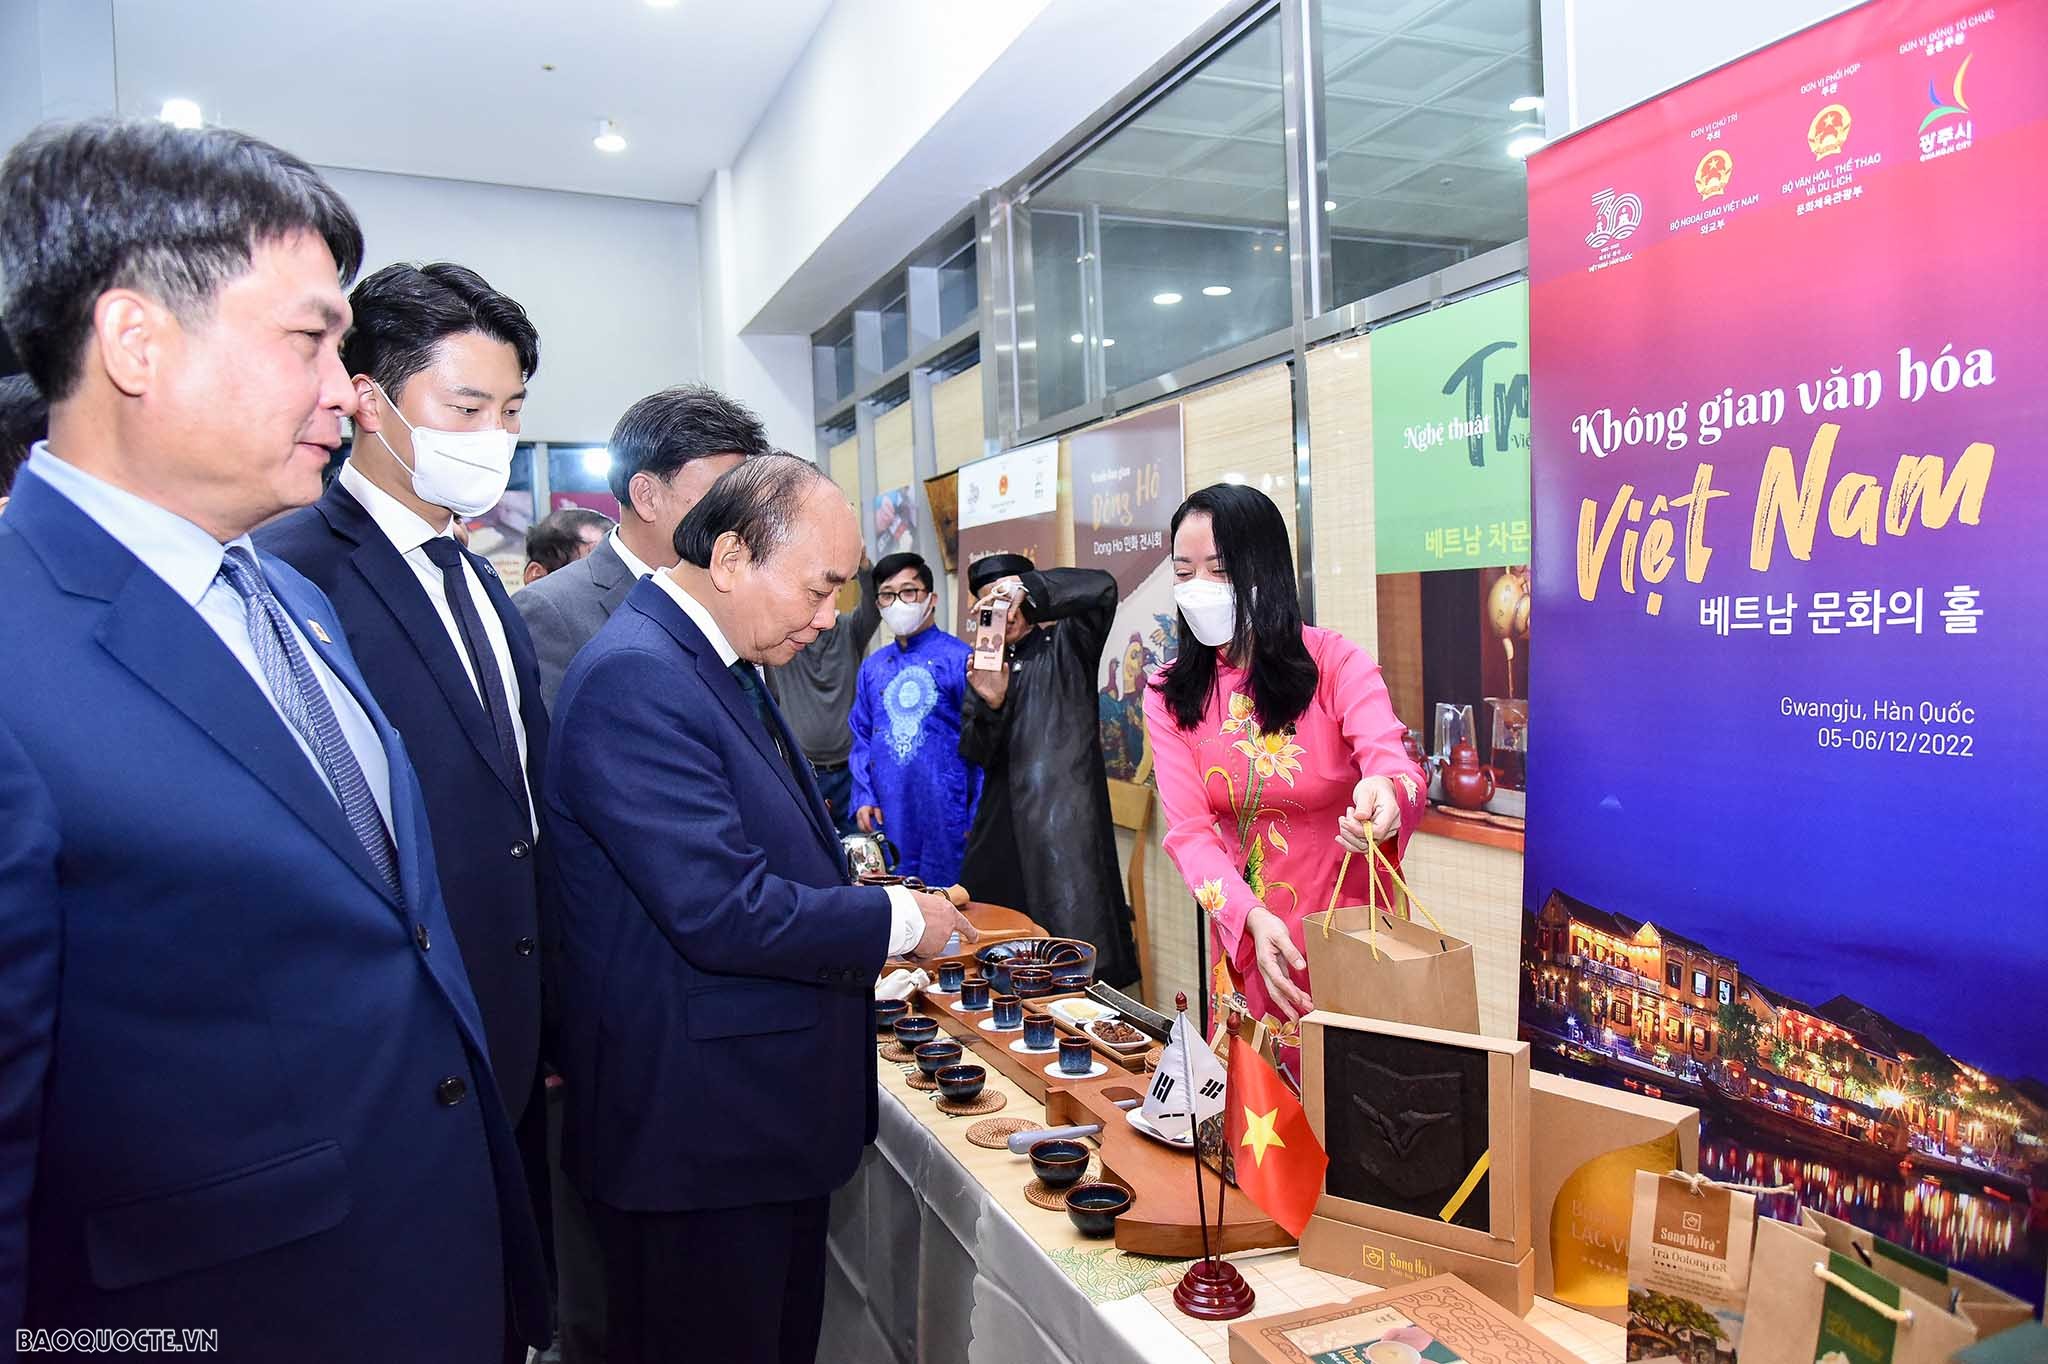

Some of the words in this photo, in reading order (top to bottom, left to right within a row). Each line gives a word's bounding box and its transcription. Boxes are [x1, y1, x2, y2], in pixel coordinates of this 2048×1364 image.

[1919, 119, 1972, 154] 광주시
[1782, 180, 1794, 195] BỘ
[1794, 174, 1811, 189] VĂN
[1834, 156, 1854, 174] THỂ
[1854, 153, 1881, 169] THAO
[1806, 183, 1817, 196] VÀ
[1818, 179, 1830, 192] DU
[1831, 171, 1853, 189] LỊCH
[1669, 219, 1680, 232] BỘ
[1680, 212, 1703, 227] NGOẠI
[1703, 206, 1722, 220] GIAO
[1723, 198, 1740, 213] VIỆT
[1741, 193, 1760, 207] NAM
[1571, 400, 1688, 458] Không
[1698, 387, 1785, 445] gian
[1796, 364, 1883, 416] văn
[1897, 343, 1996, 402] hóa
[1403, 422, 1445, 452] Nghệ
[1448, 414, 1491, 441] thuật
[1576, 462, 1730, 616] Việt
[1750, 422, 1996, 572] Nam
[1093, 541, 1112, 556] Dong
[1112, 538, 1124, 553] Ho
[1139, 531, 1162, 551] 전시회
[1425, 526, 1482, 559] 베트남
[1700, 591, 1798, 637] 베트남
[1807, 587, 1924, 636] 문화의
[1939, 584, 1984, 635] 홀
[1780, 696, 1868, 724] Gwangju,
[1873, 698, 1914, 722] Hàn
[1918, 699, 1975, 726] Quốc
[1817, 727, 1975, 758] 05-06/12/2022
[1390, 1252, 1413, 1274] Song
[1672, 1252, 1710, 1272] Oolong
